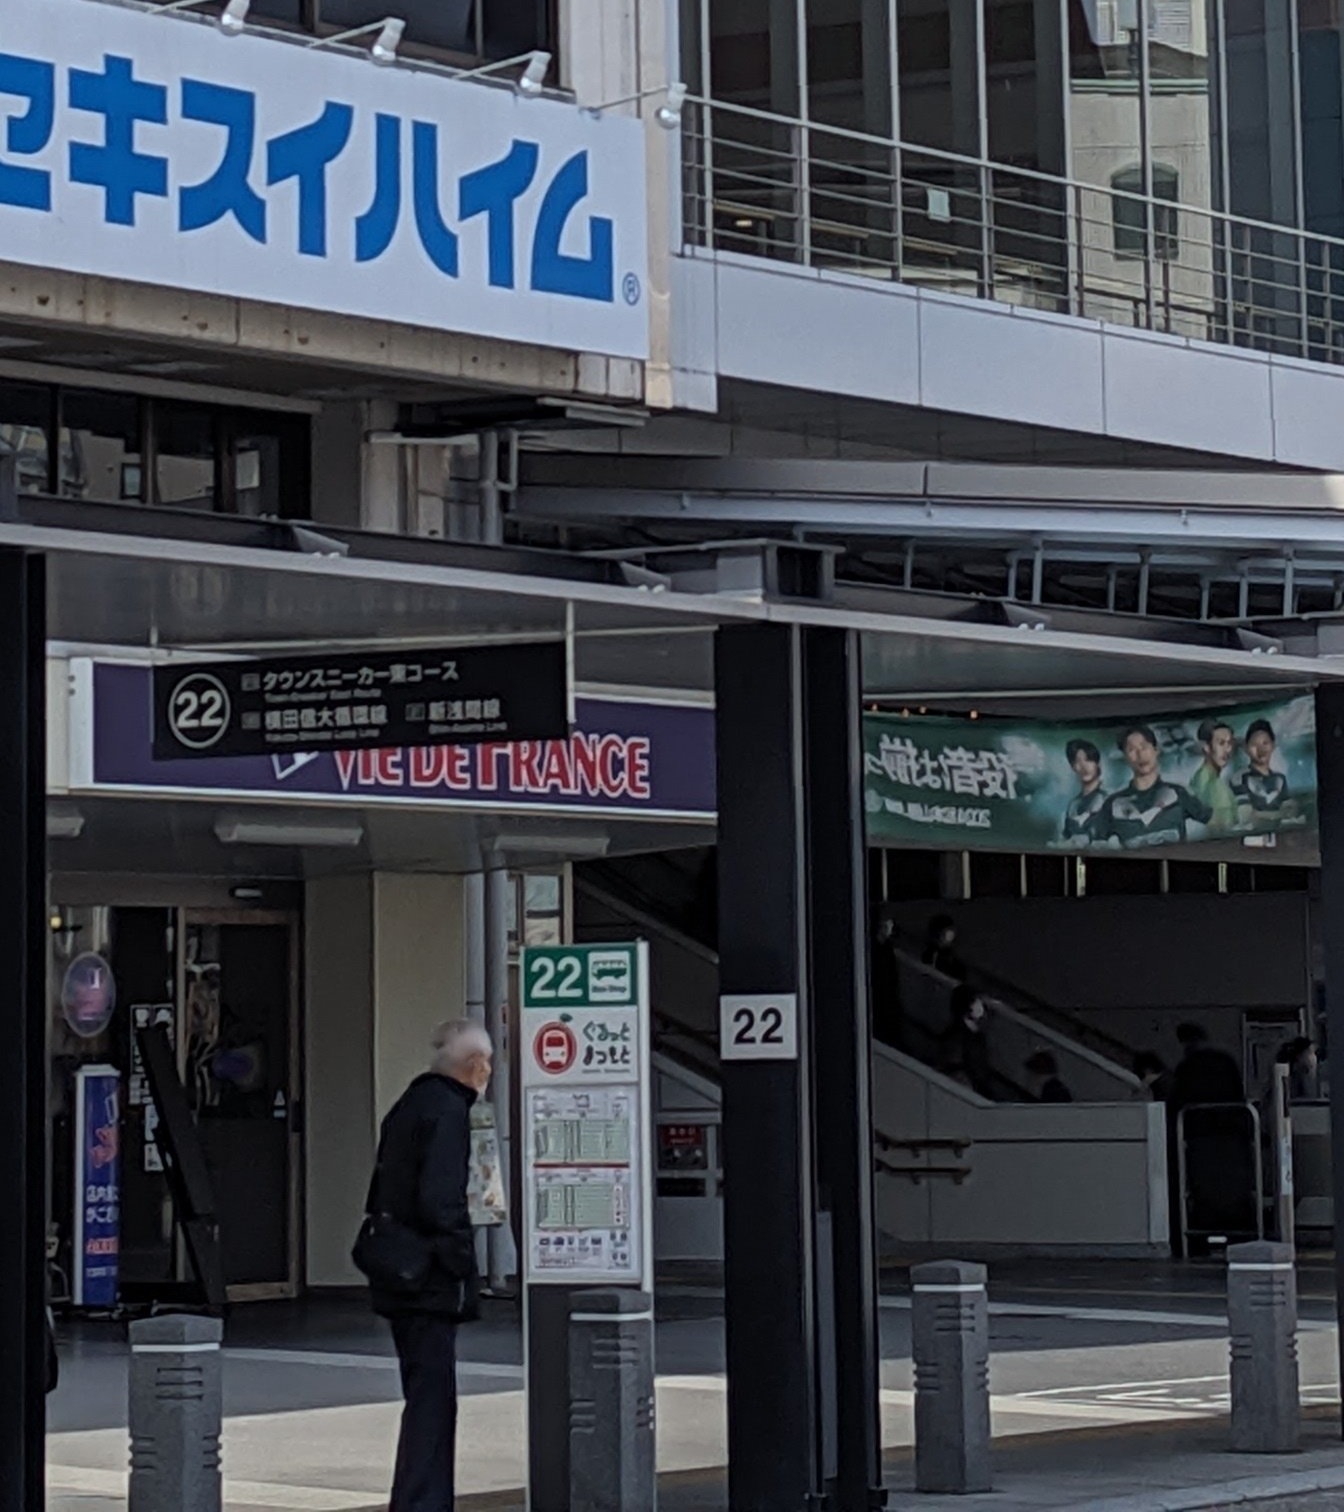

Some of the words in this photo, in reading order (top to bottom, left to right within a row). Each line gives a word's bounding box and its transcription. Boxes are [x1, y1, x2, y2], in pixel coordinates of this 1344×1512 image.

[176, 691, 224, 727] 22
[408, 743, 471, 790] DE
[477, 731, 651, 799] FRANCE
[530, 957, 583, 998] 22
[583, 1021, 631, 1042] ぐるっと
[733, 1007, 783, 1045] 22
[582, 1045, 631, 1066] まつもと
